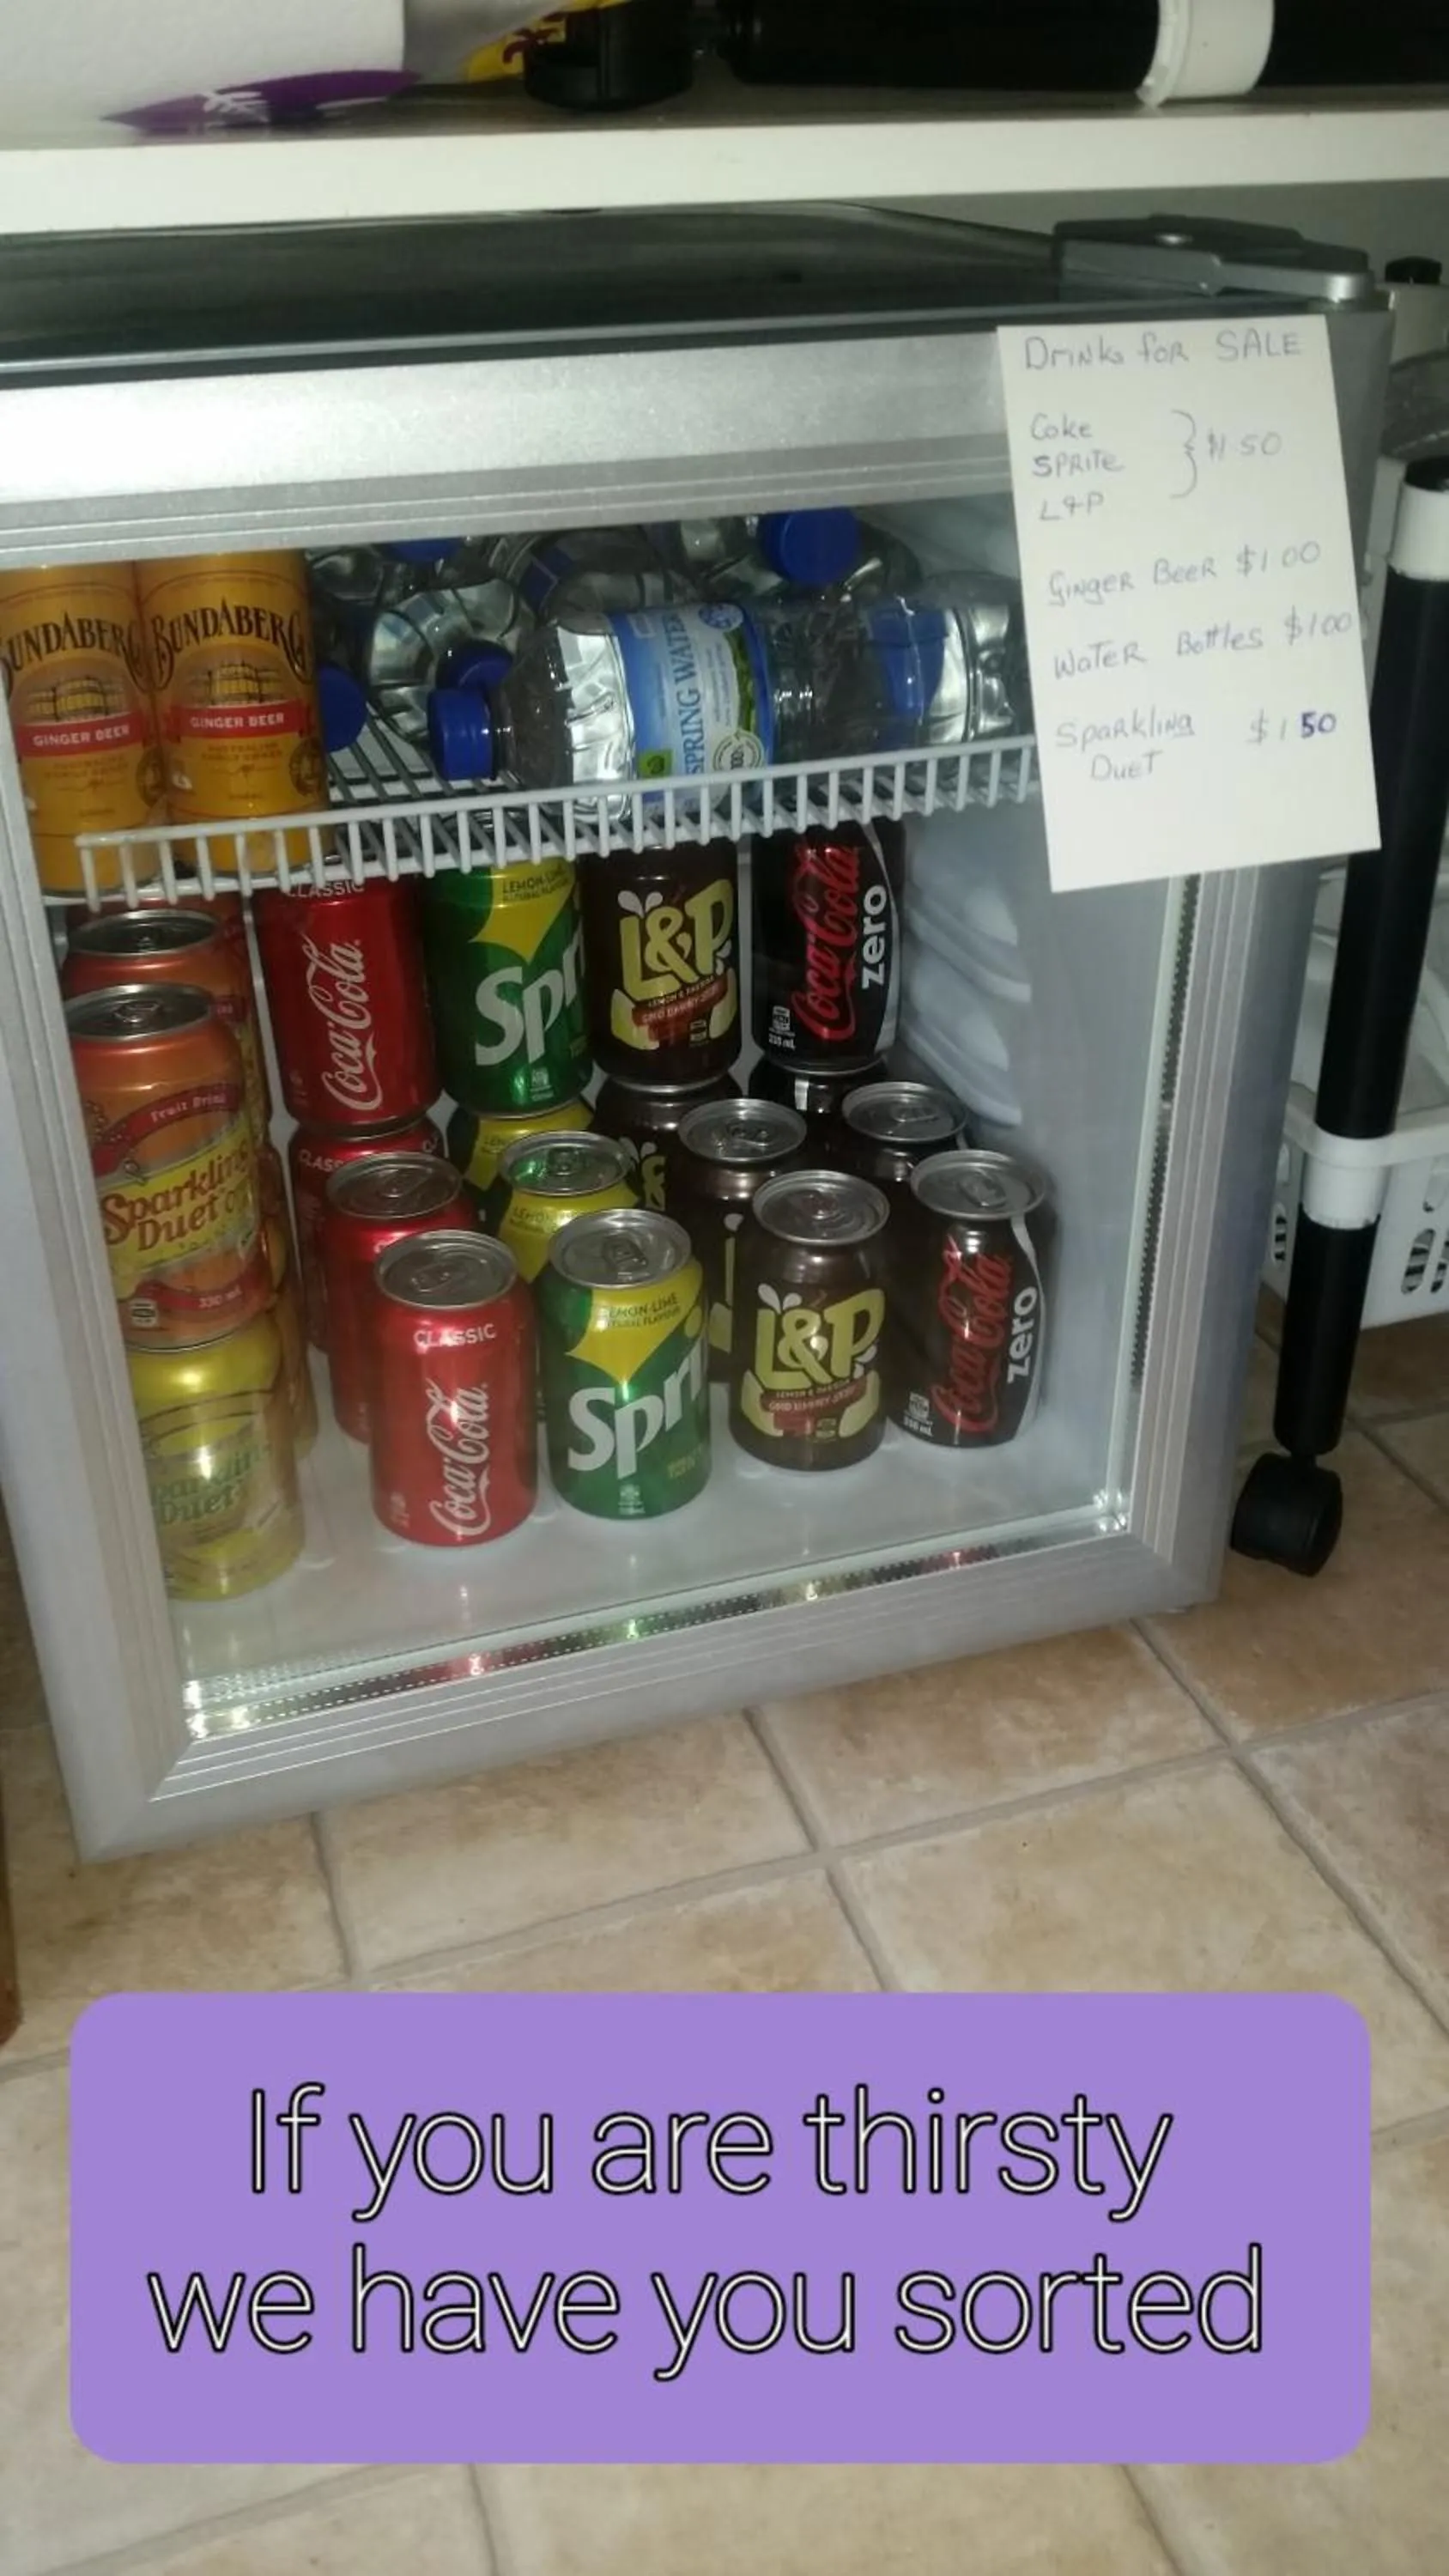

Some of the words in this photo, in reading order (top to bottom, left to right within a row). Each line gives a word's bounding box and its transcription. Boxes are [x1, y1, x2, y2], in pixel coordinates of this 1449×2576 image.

[1216, 328, 1302, 362] SALE
[1029, 411, 1094, 441] Coke
[150, 598, 314, 691] BUNDABERG
[32, 730, 92, 748] GINGER
[95, 725, 130, 742] BEER
[190, 714, 244, 730] GINGER
[248, 712, 285, 727] BEER
[675, 688, 706, 775] SPRING
[285, 879, 366, 898] CLASSIC
[619, 878, 735, 1005] L&P
[862, 884, 887, 989] zero
[138, 1194, 221, 1250] Duet
[413, 1322, 498, 1354] CLASSIC
[755, 1288, 885, 1390] L&P
[1007, 1286, 1038, 1383] zero
[425, 1377, 491, 1537] Coca-Cola
